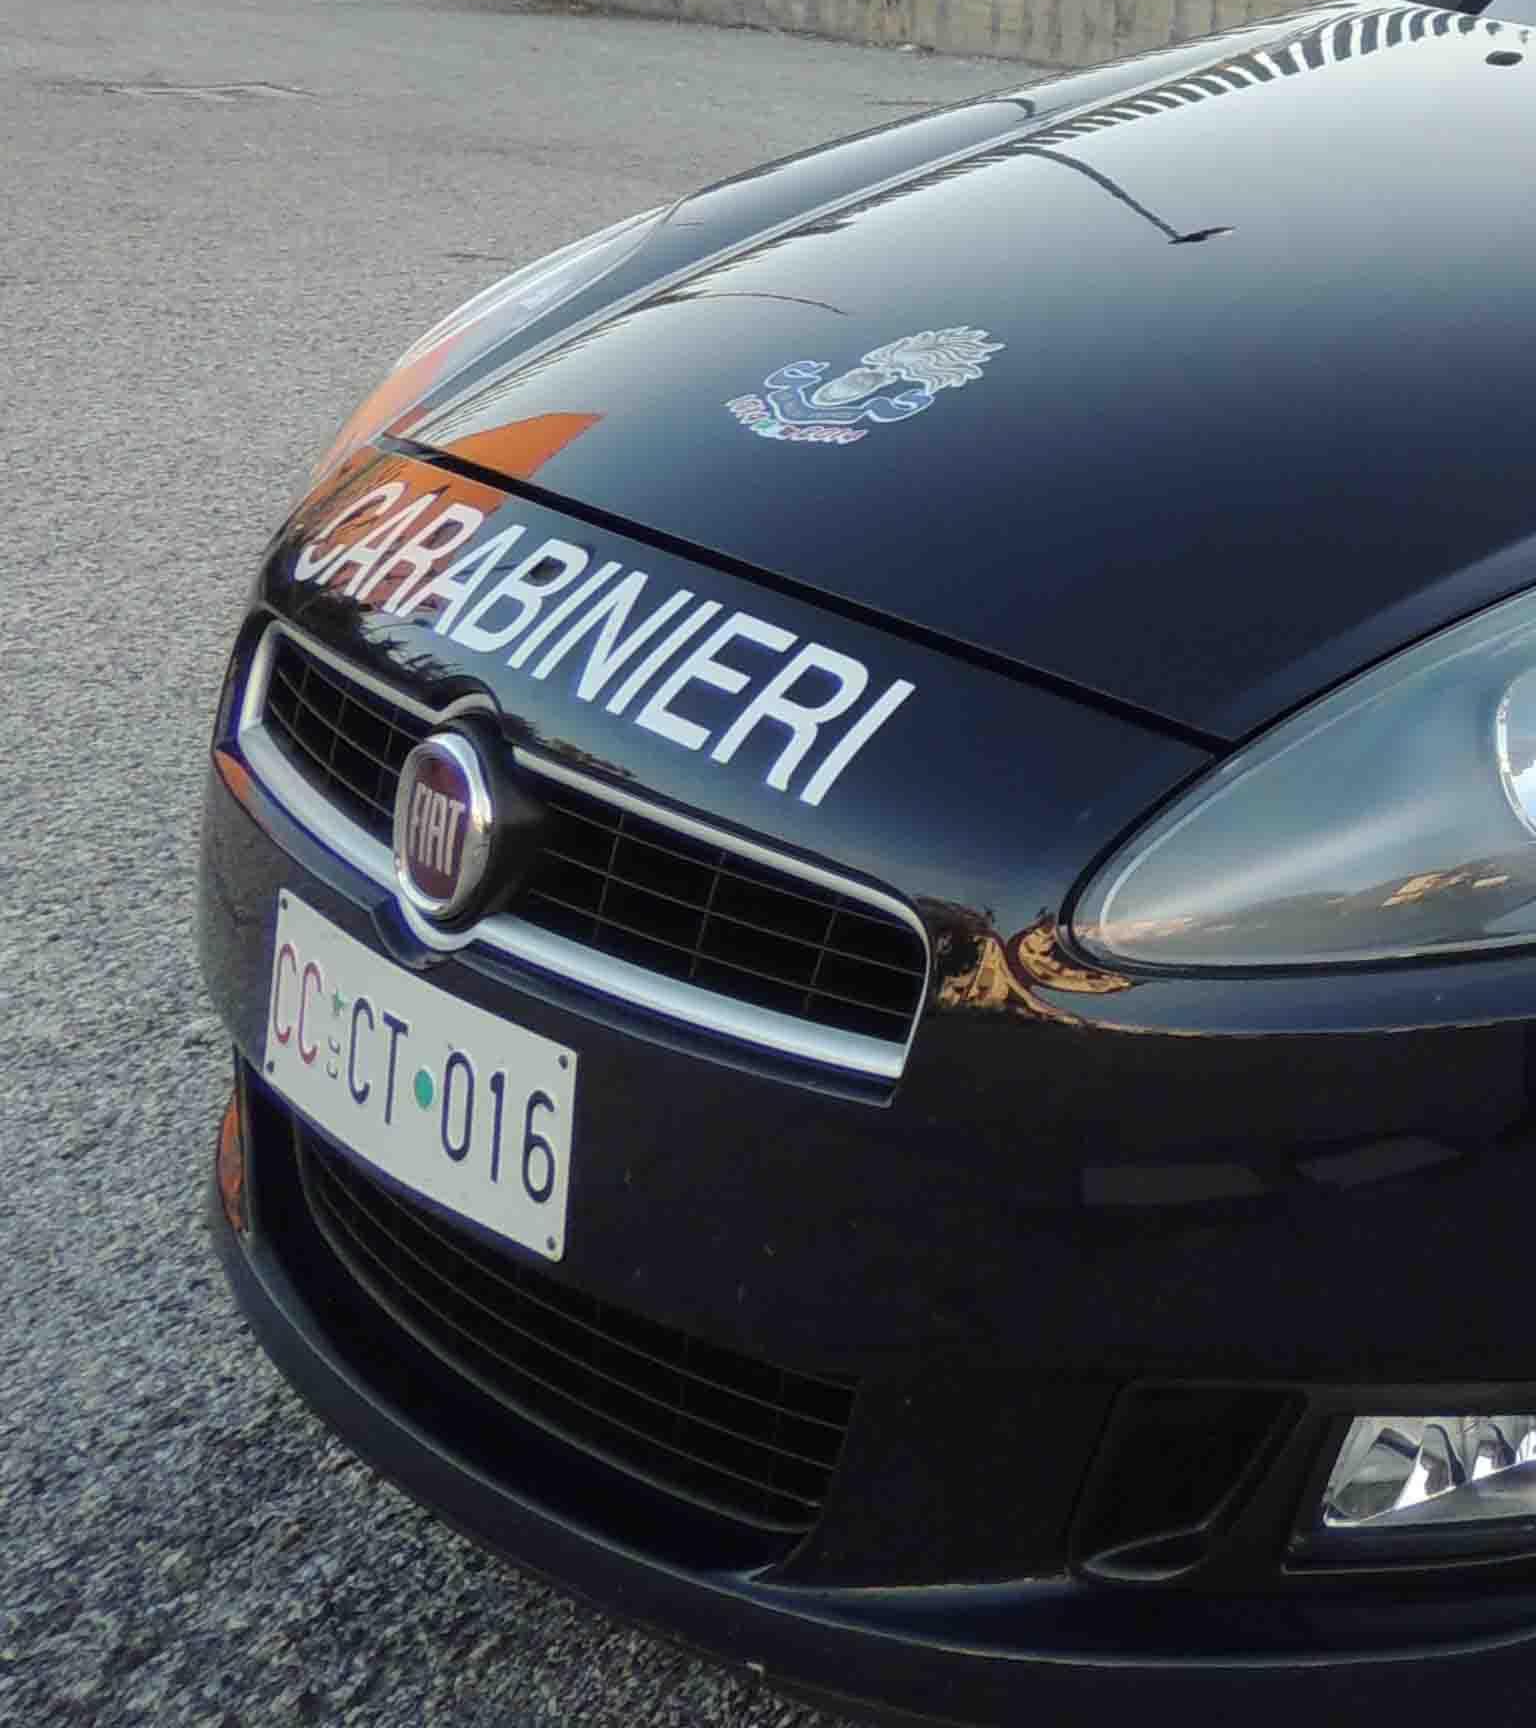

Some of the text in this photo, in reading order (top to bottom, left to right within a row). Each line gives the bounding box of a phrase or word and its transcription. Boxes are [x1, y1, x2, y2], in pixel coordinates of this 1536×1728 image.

[294, 481, 915, 806] CARABINIERI
[408, 781, 467, 877] FIAT
[273, 943, 557, 1204] CC CT 016
